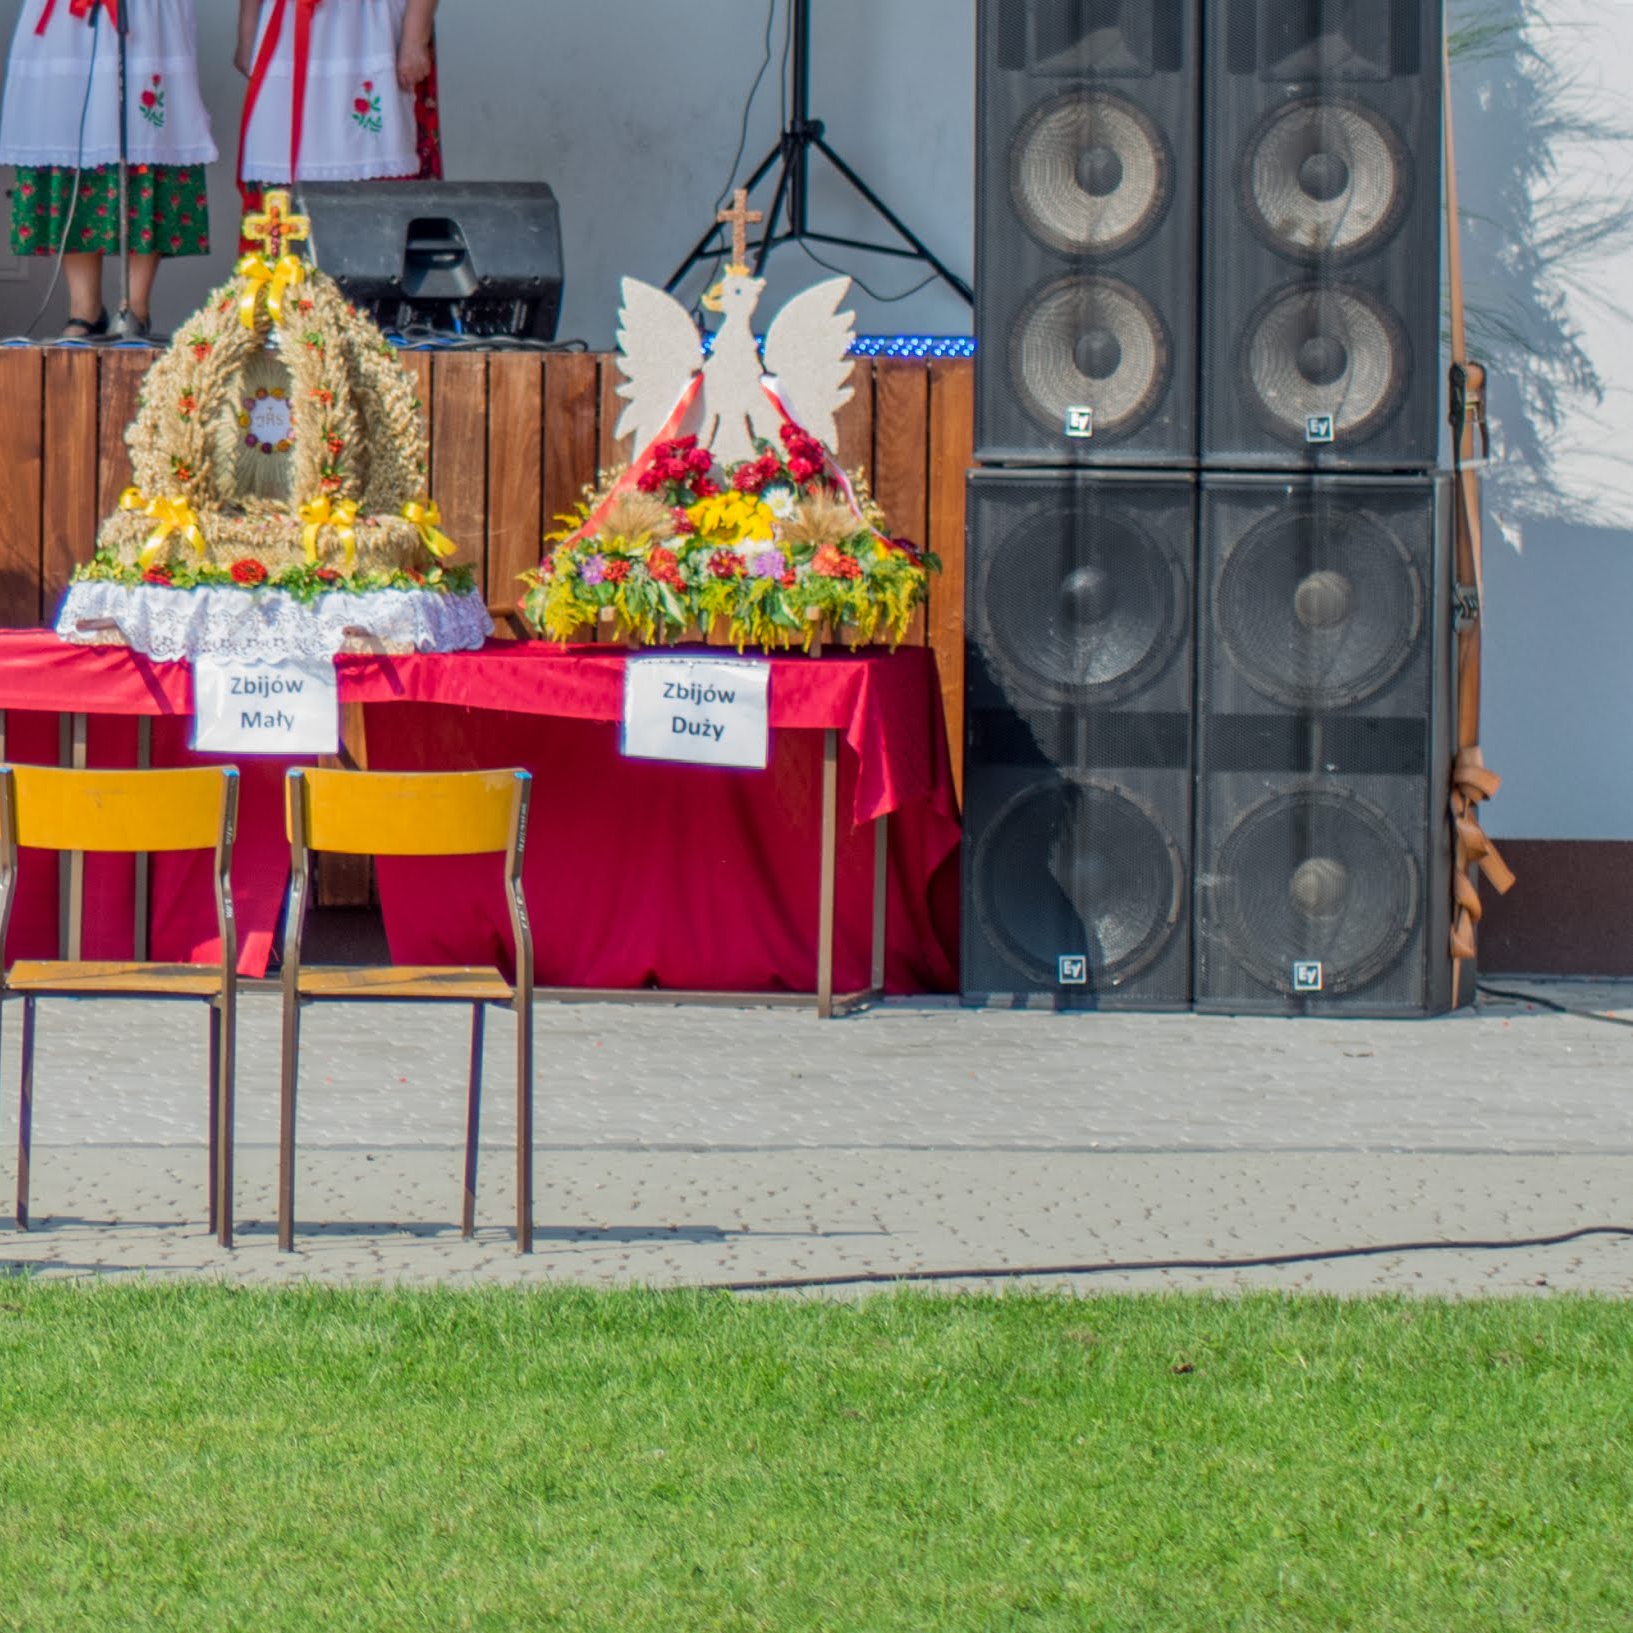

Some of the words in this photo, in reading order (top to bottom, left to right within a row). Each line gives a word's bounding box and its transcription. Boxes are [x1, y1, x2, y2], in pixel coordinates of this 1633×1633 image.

[230, 674, 304, 699] Zbijów
[663, 681, 736, 706] Zbijów
[241, 709, 295, 731] Mały
[671, 716, 725, 742] Duży
